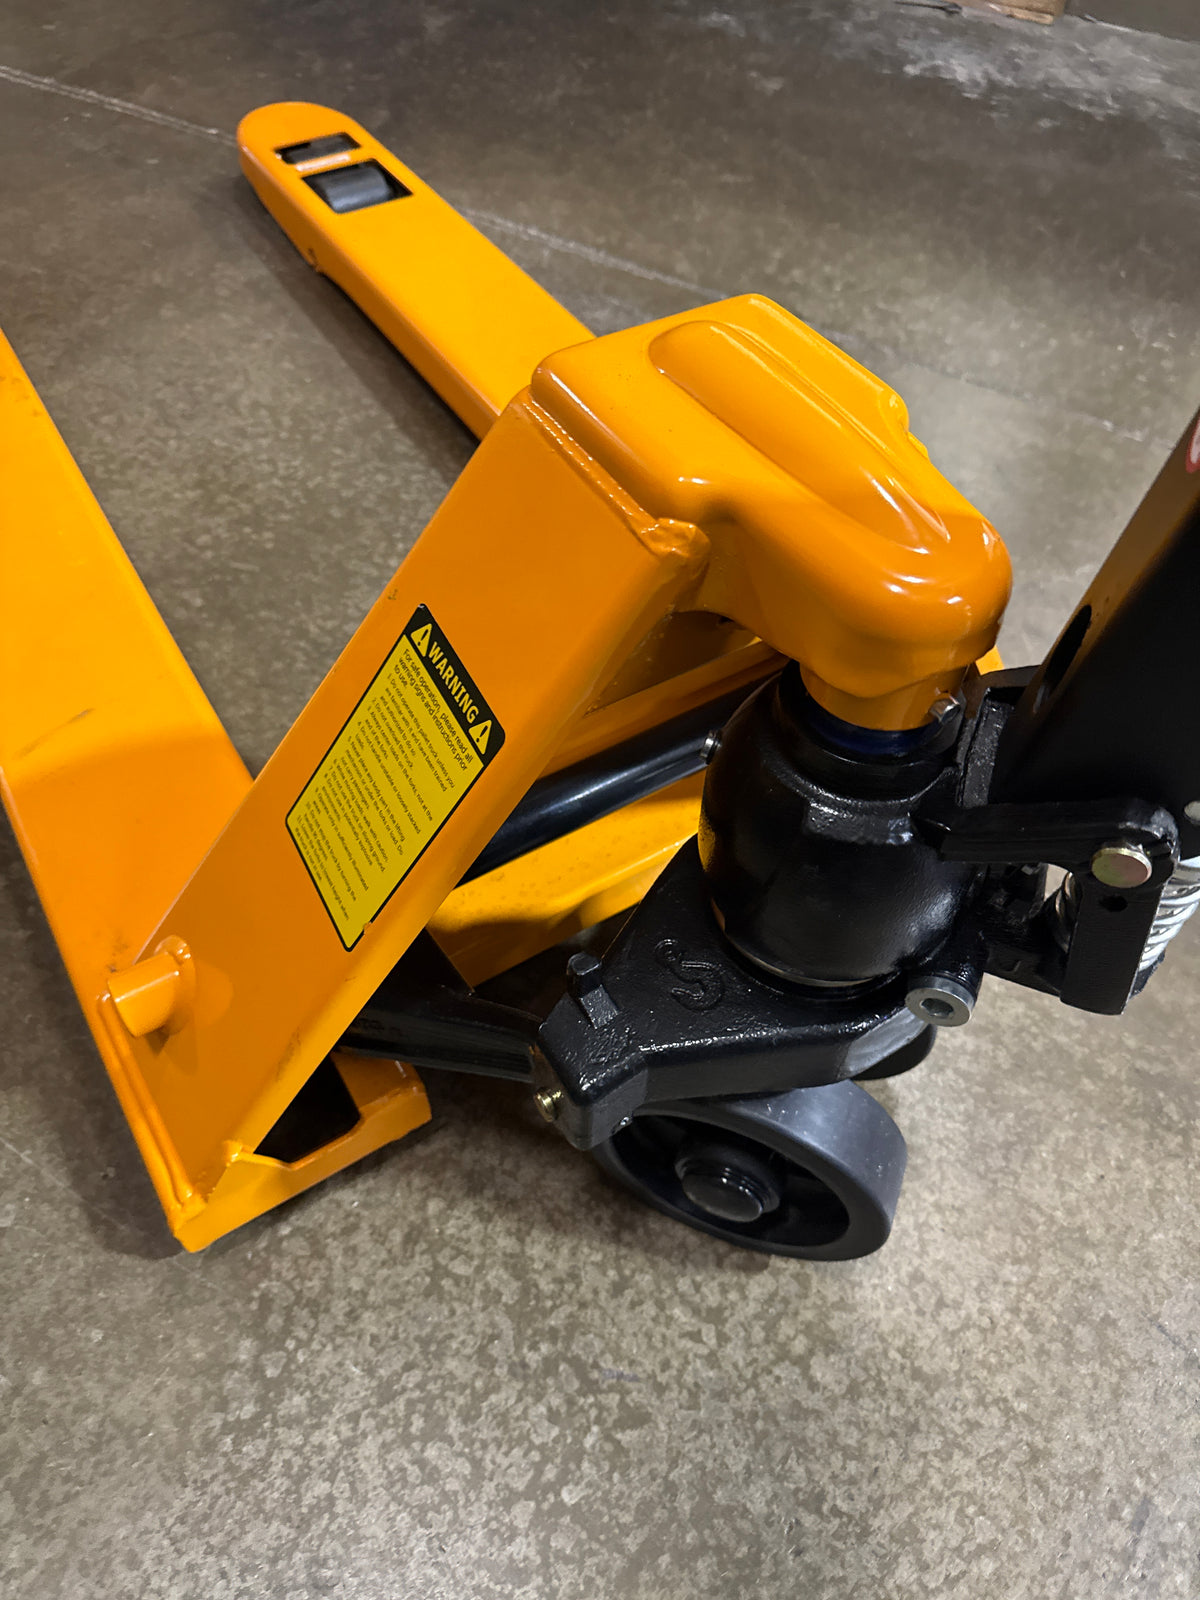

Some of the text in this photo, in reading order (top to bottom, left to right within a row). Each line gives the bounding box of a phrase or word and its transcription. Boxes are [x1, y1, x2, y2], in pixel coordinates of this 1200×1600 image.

[393, 663, 401, 675] to
[397, 655, 468, 773] warning signs and instructions prior
[402, 647, 474, 763] For safe operation, please read all
[425, 639, 480, 725] WARNING
